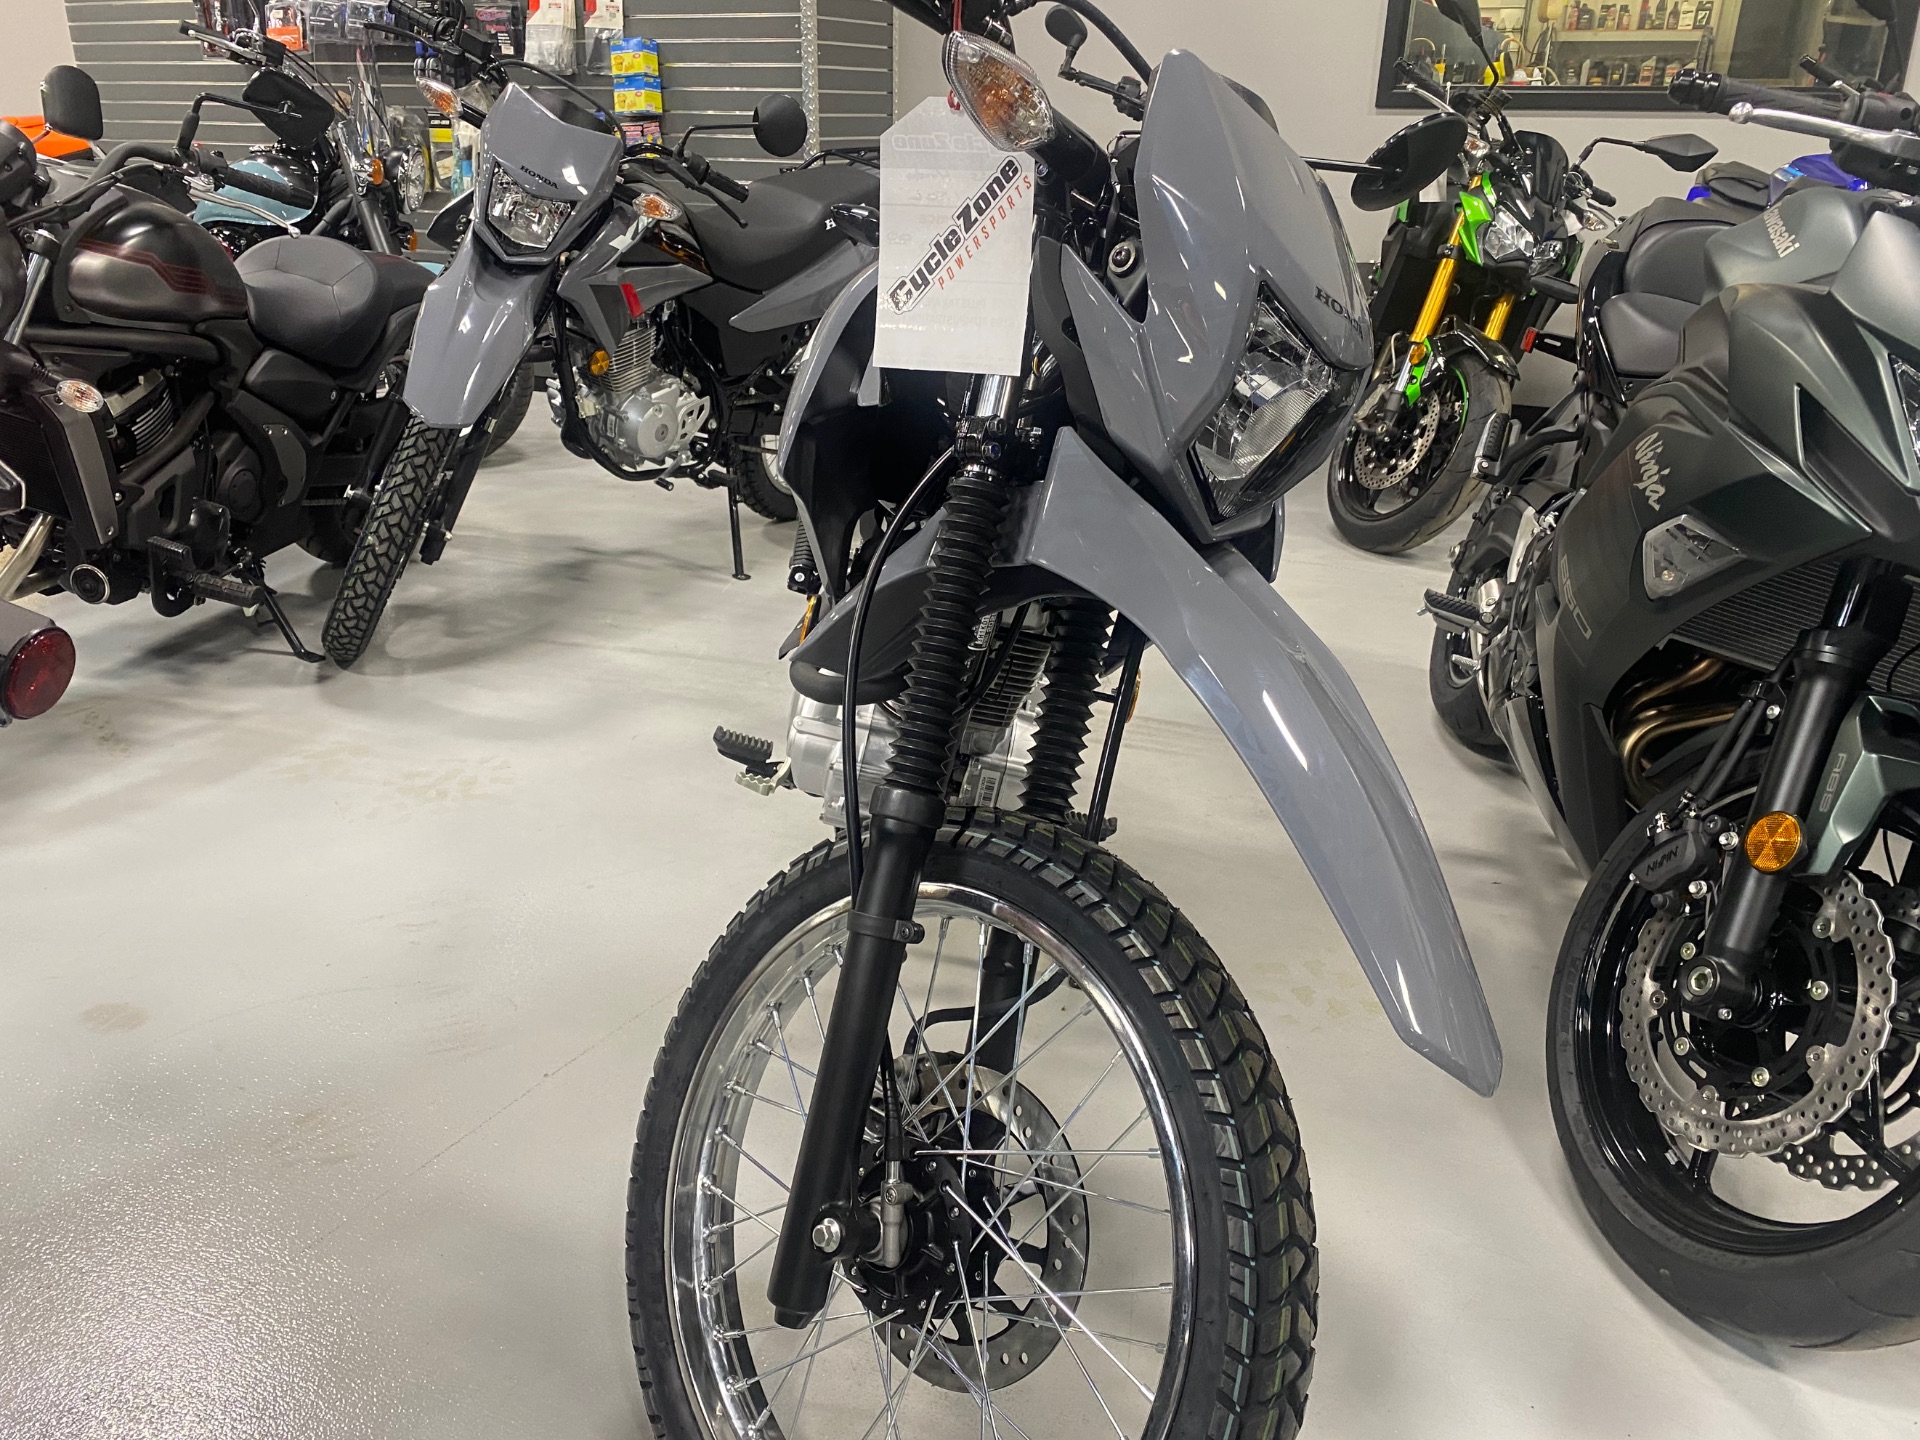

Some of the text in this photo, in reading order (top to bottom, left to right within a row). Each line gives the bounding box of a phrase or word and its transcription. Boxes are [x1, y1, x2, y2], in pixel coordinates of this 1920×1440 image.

[520, 165, 558, 189] HONDA
[937, 175, 1032, 290] POWERSPORTS
[1314, 286, 1364, 340] HONDA
[1635, 432, 1666, 511] Ninja
[1559, 553, 1592, 640] 650
[1819, 752, 1846, 813] ABS
